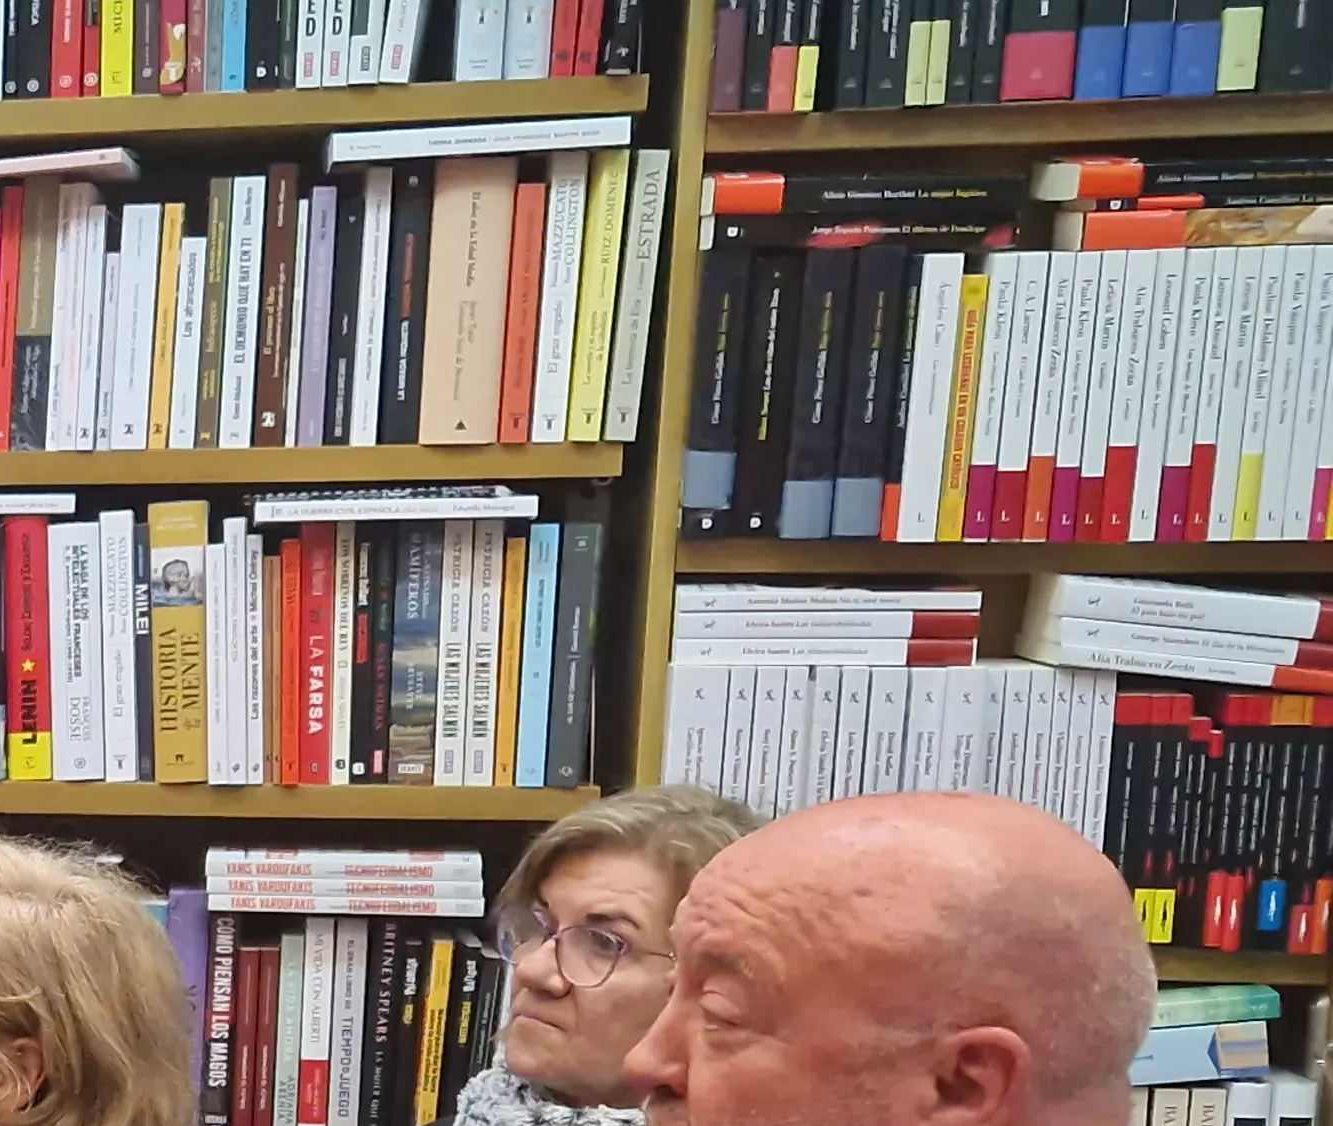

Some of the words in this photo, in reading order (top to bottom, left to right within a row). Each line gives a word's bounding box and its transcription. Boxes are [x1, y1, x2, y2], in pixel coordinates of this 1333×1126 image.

[551, 178, 568, 261] MAZZUCATO
[564, 178, 580, 265] COLLINGTON
[635, 169, 660, 260] ESTRADA
[240, 237, 252, 247] TI
[240, 249, 251, 263] EN
[601, 236, 611, 264] RUIZ
[238, 265, 251, 282] HAY
[236, 284, 249, 304] QUE
[997, 280, 1010, 310] Paula
[1079, 278, 1093, 308] Paula
[1161, 273, 1177, 316] Leonard
[1192, 276, 1206, 306] Paula
[235, 306, 248, 351] DEMONIO
[993, 312, 1006, 340] Klein
[1075, 310, 1089, 338] Klein
[1157, 318, 1173, 351] Cohen
[1189, 308, 1202, 337] Klein
[233, 352, 245, 363] EL
[79, 545, 88, 557] LA
[72, 545, 81, 621] INTELECTUALES
[79, 559, 89, 585] SAGA
[107, 536, 116, 613] MAZZUCATO
[119, 536, 129, 616] COLLINGTON
[80, 587, 89, 600] DE
[135, 583, 149, 635] MILEI
[80, 602, 89, 621] LOS
[249, 625, 258, 644] arte
[309, 635, 324, 659] LA
[73, 623, 82, 678] FRANCESES
[249, 646, 258, 660] del
[445, 642, 462, 659] LAS
[475, 642, 492, 659] LAS
[1089, 652, 1111, 664] Alia
[1114, 655, 1162, 670] Trabucco
[1163, 659, 1196, 674] Zerán
[158, 627, 178, 732] HISTORIA
[181, 632, 200, 710] MENTE
[249, 663, 259, 700] razones
[444, 661, 461, 702] MUJERES
[474, 661, 491, 702] MUJERES
[21, 680, 37, 745] LENIN
[250, 702, 259, 720] Las
[308, 665, 323, 734] FARSA
[69, 697, 83, 741] DOSSE
[443, 704, 460, 738] SALMÓN
[473, 704, 490, 738] SALMÓN
[226, 863, 254, 875] YANIS
[256, 864, 312, 876] VAROUFAKIS
[228, 880, 255, 892] YANIS
[257, 881, 314, 894] VAROUFAKIS
[230, 897, 257, 909] YANIS
[259, 898, 315, 910] VAROUFAKIS
[216, 918, 236, 954] CÓMO
[314, 934, 322, 945] MI
[313, 948, 322, 974] VIDA
[380, 923, 397, 985] BRITNEY
[213, 957, 234, 1012] PIENSAN
[287, 963, 295, 977] LA
[286, 980, 294, 1013] VIDA
[312, 977, 321, 1000] CON
[211, 1015, 231, 1040] LOS
[310, 1004, 320, 1043] ALBERTI
[375, 989, 391, 1044] SPEARS
[283, 1017, 292, 1063] AHORA
[341, 1017, 354, 1065] TIEMPO
[208, 1042, 227, 1087] MAGOS
[337, 1075, 351, 1118] JUEGO
